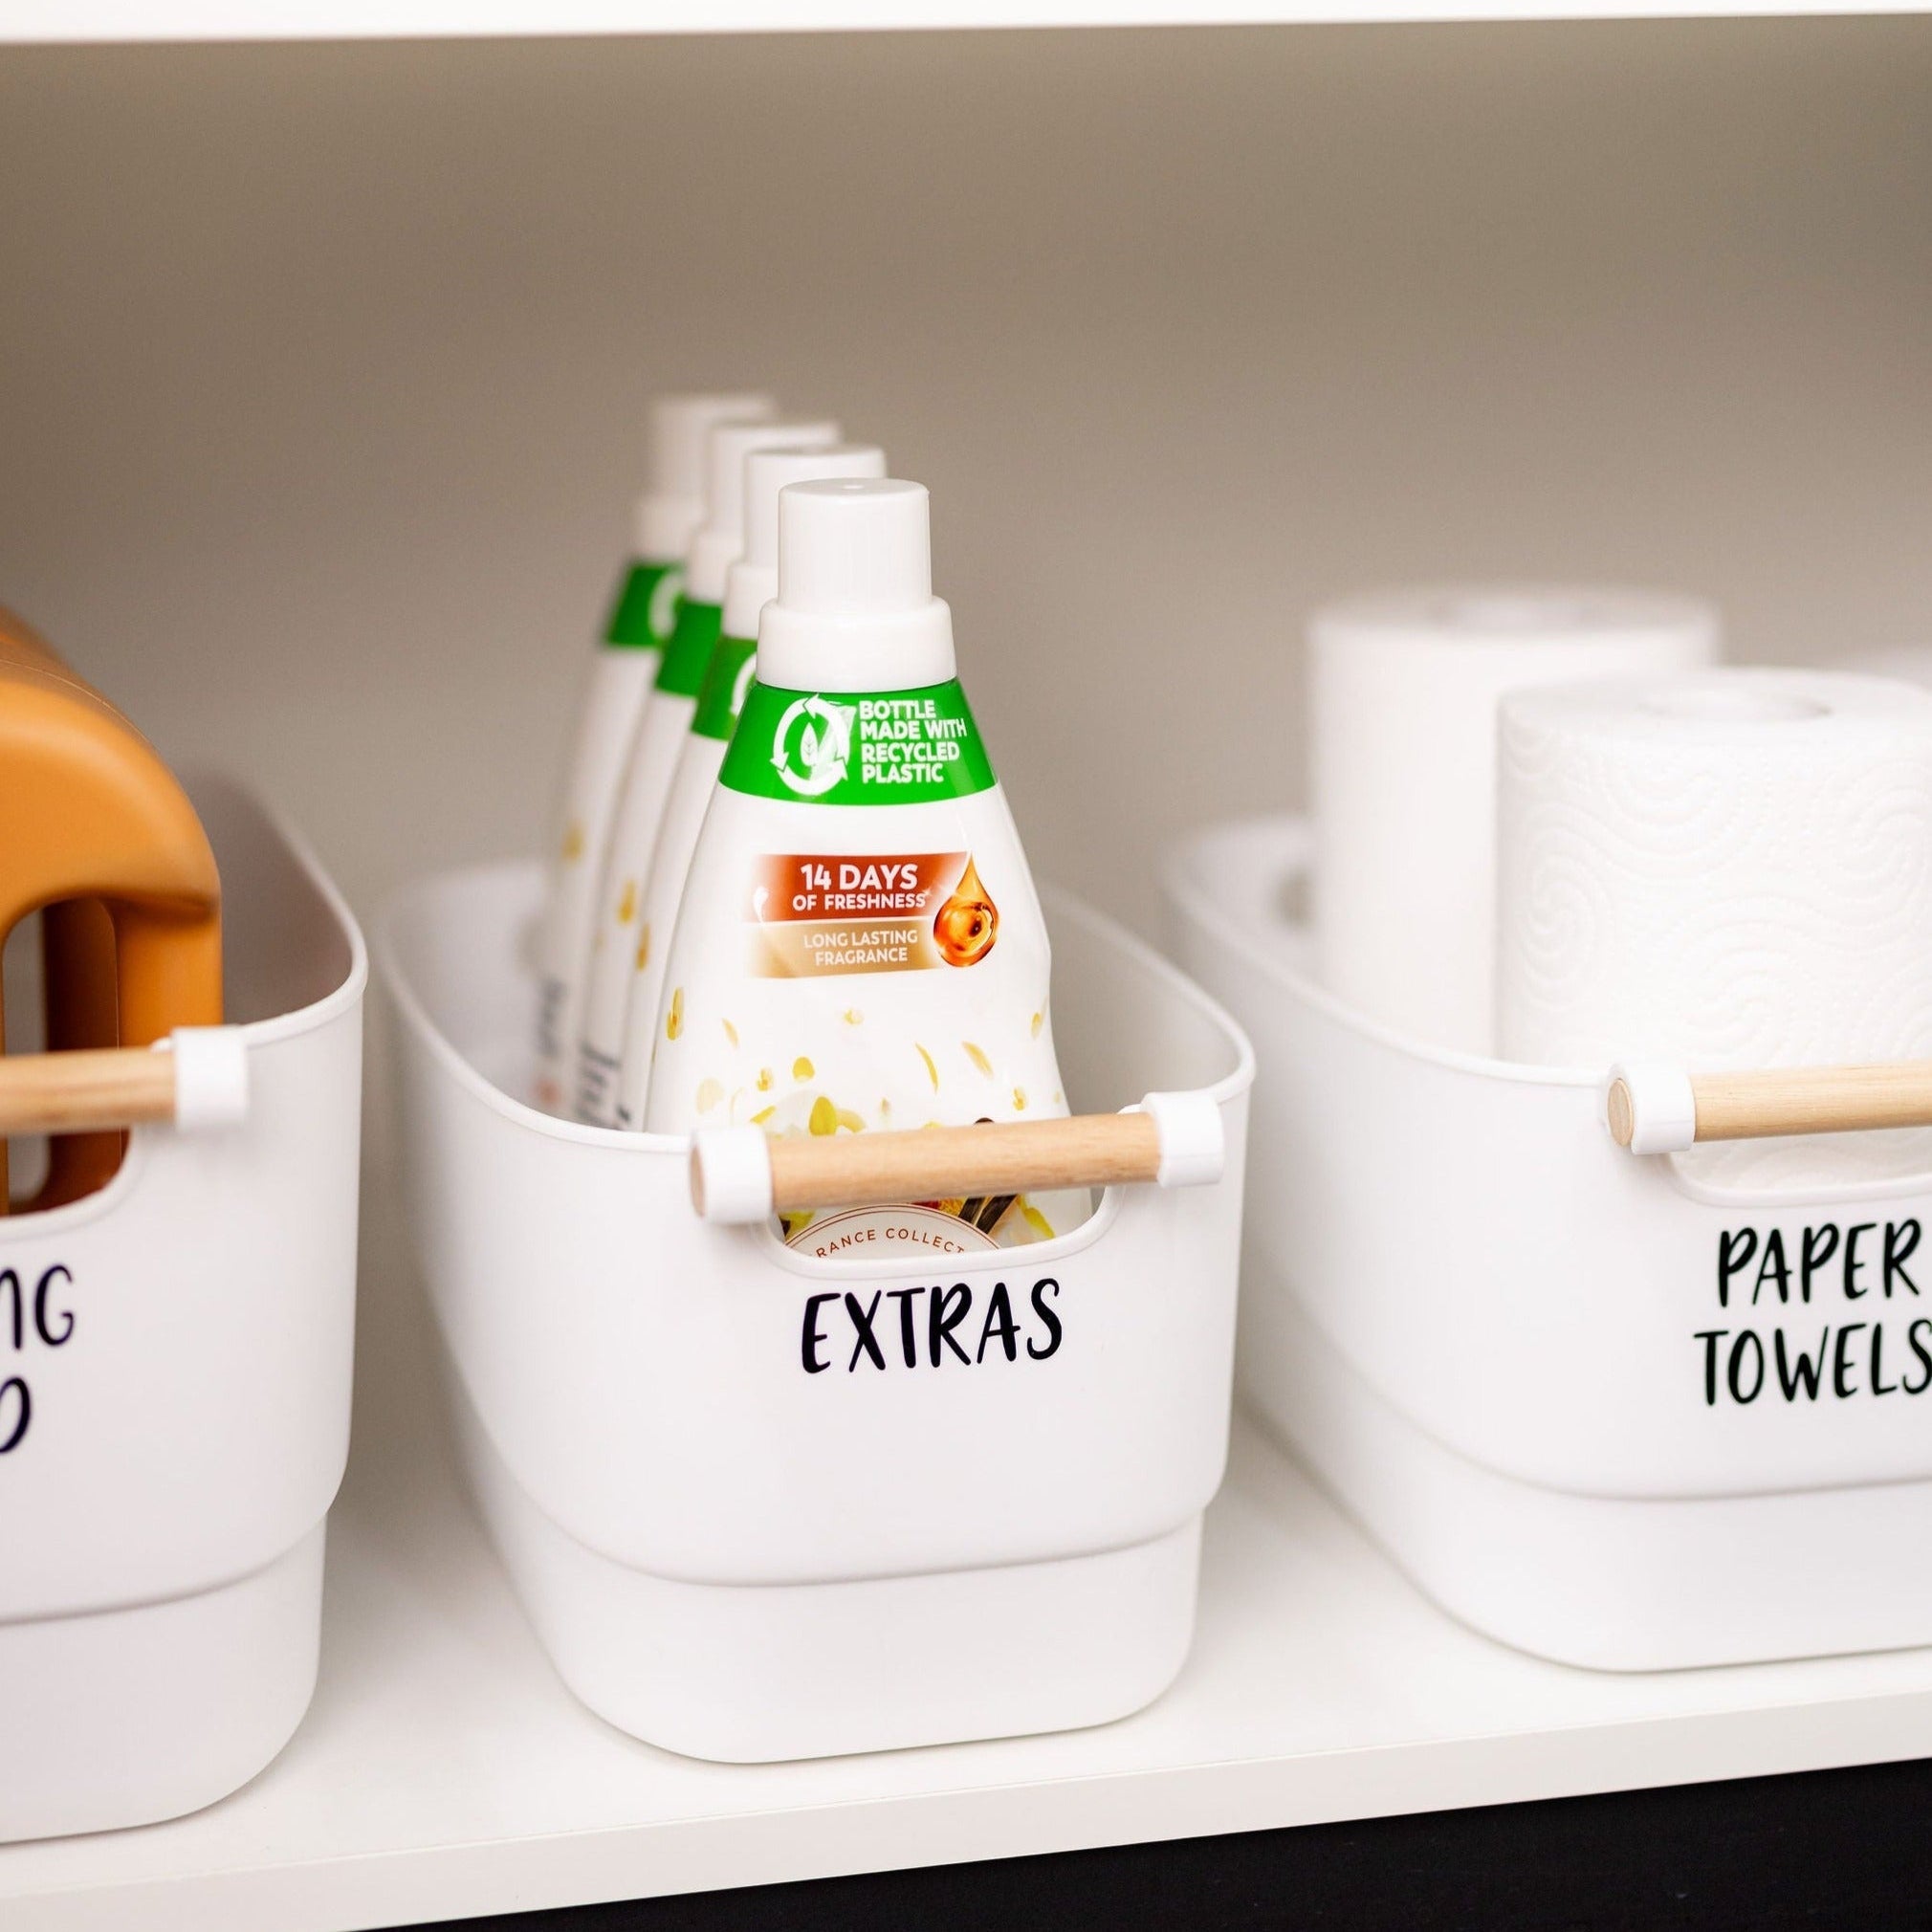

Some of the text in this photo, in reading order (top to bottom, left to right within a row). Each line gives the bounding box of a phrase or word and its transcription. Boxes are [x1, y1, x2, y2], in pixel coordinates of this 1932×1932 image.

[859, 699, 936, 719] BOTTLE
[860, 717, 967, 740] MADE WITH
[861, 741, 960, 763] RECYCLED
[862, 763, 944, 783] PLASTIC
[801, 863, 918, 890] 14 DAYS
[792, 894, 818, 911] OF
[803, 929, 918, 950] LONG LASTING
[815, 947, 909, 966] FRAGRANCE
[1718, 1218, 1921, 1308] PAPER
[801, 1278, 1063, 1373] EXTRAS
[1693, 1319, 1932, 1406] TOWELS
